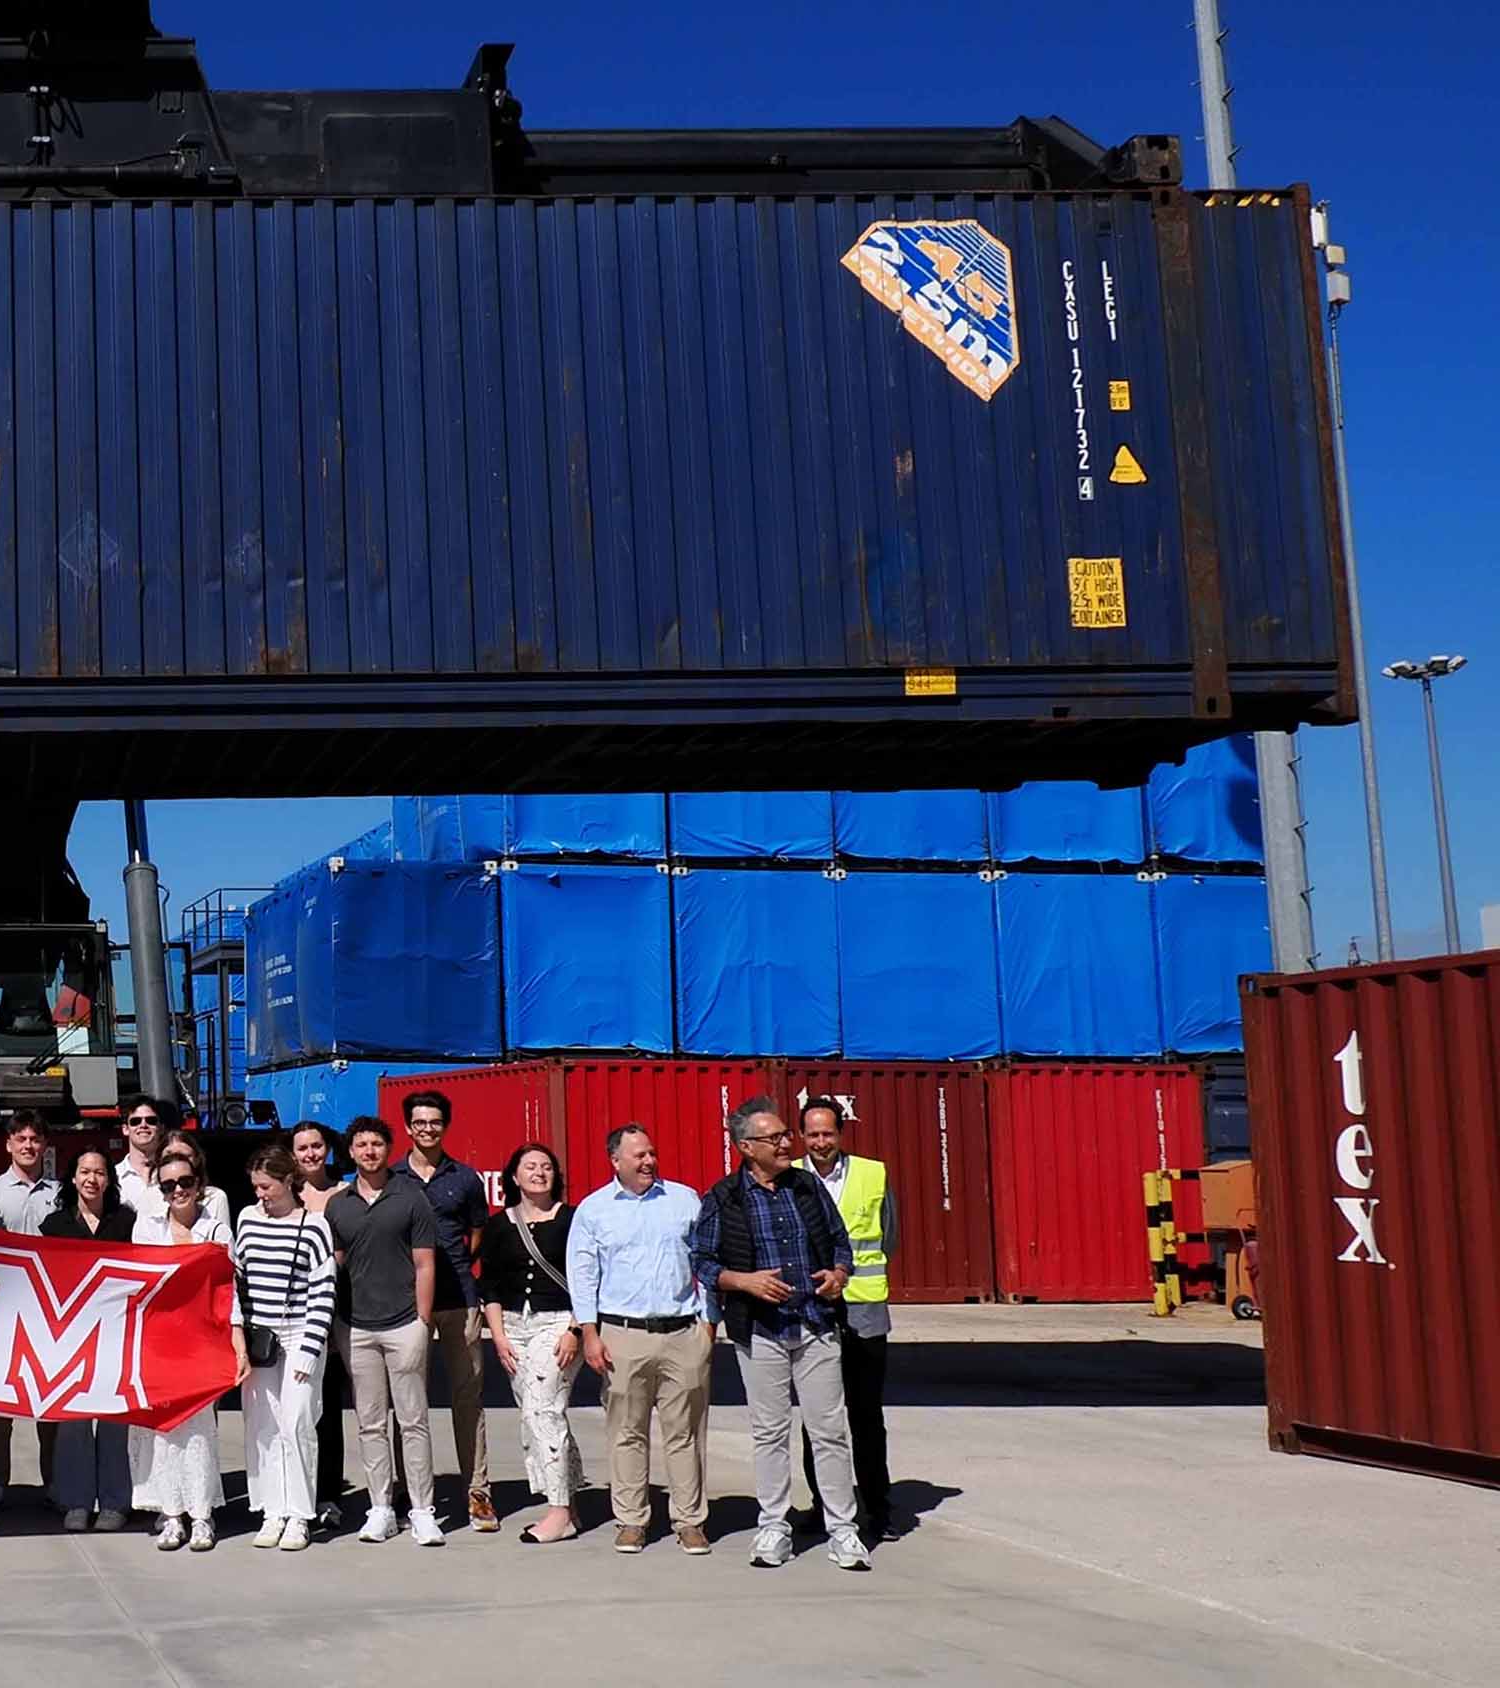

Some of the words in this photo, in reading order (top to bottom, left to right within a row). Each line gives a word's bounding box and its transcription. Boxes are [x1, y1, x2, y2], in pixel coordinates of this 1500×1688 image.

[859, 231, 1009, 379] 2.5m
[1062, 260, 1079, 341] CXSU
[1101, 260, 1117, 341] LEG1
[1071, 347, 1090, 470] 121732
[1077, 476, 1094, 501] 4
[1094, 577, 1118, 591] HIGH
[1096, 593, 1121, 608] WIDE
[1072, 609, 1124, 624] CONTAINER
